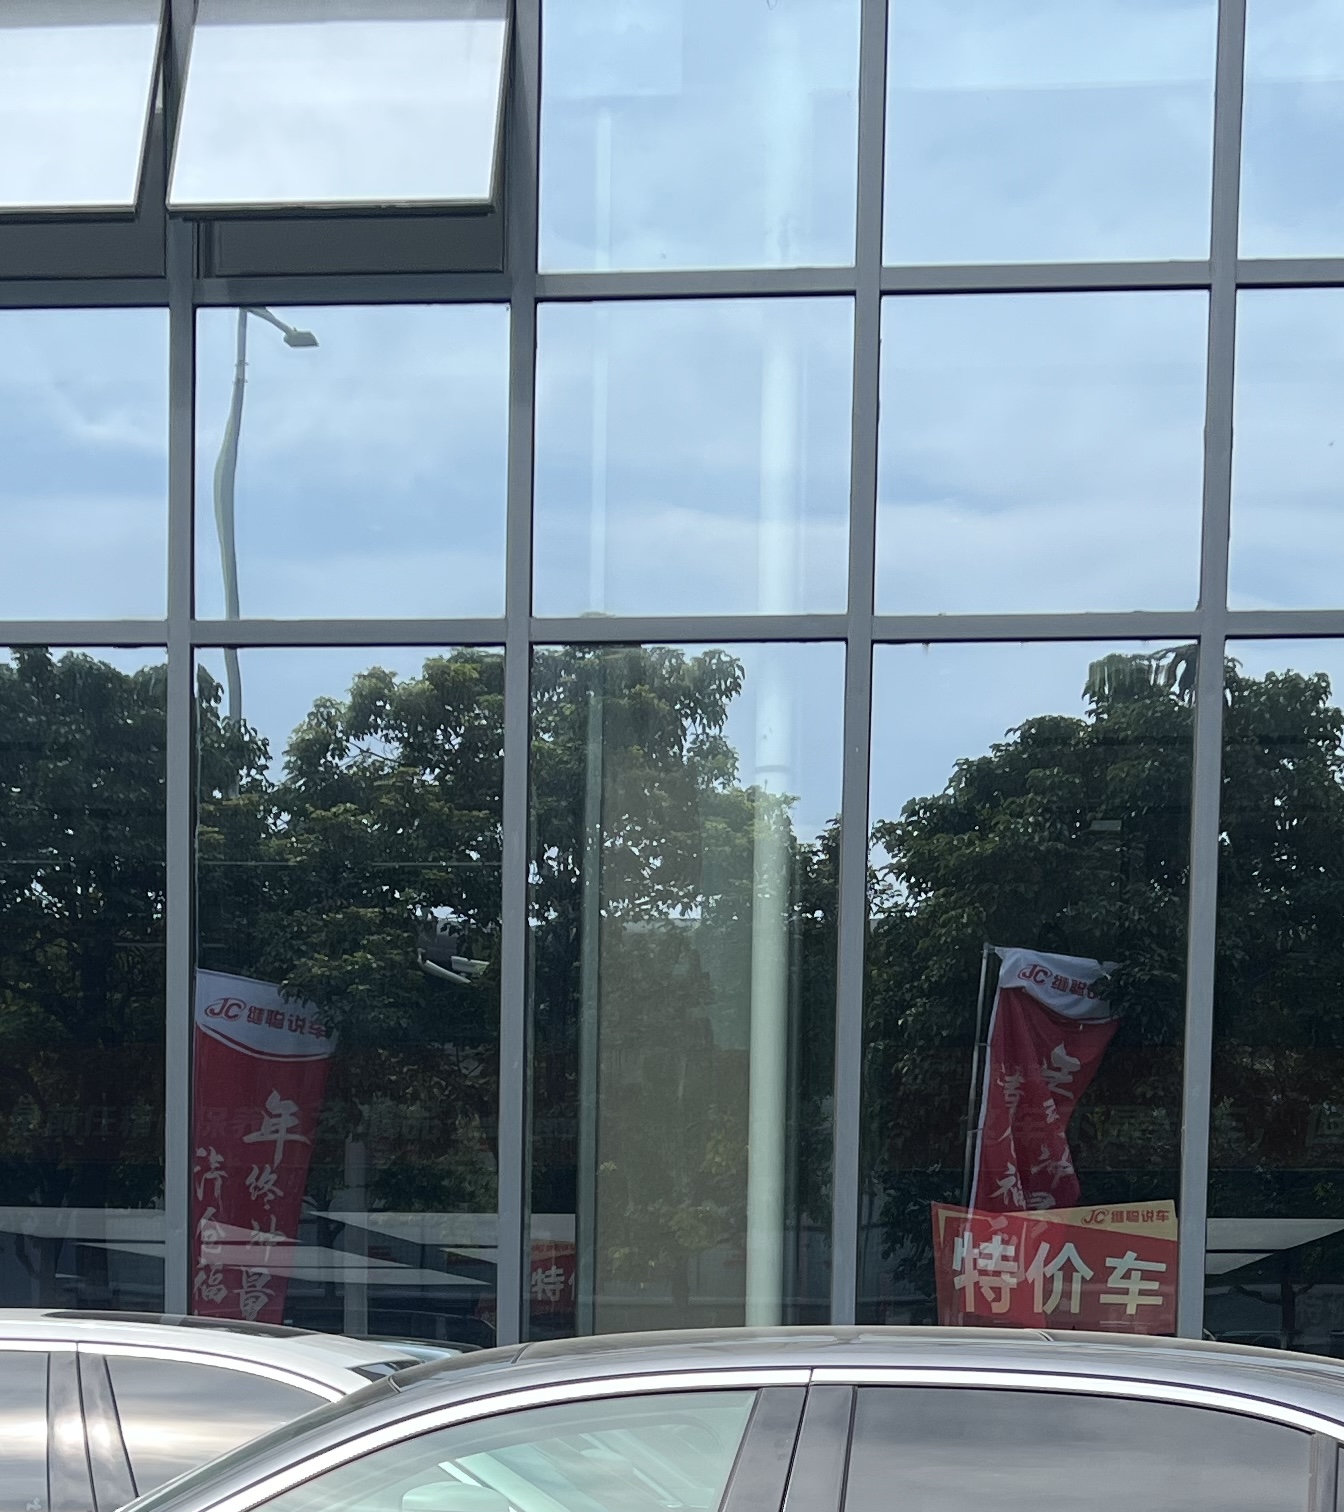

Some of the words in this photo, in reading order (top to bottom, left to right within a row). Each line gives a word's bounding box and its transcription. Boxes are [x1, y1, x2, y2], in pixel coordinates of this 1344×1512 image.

[204, 997, 247, 1022] JC
[952, 1231, 1167, 1316] 特价车
